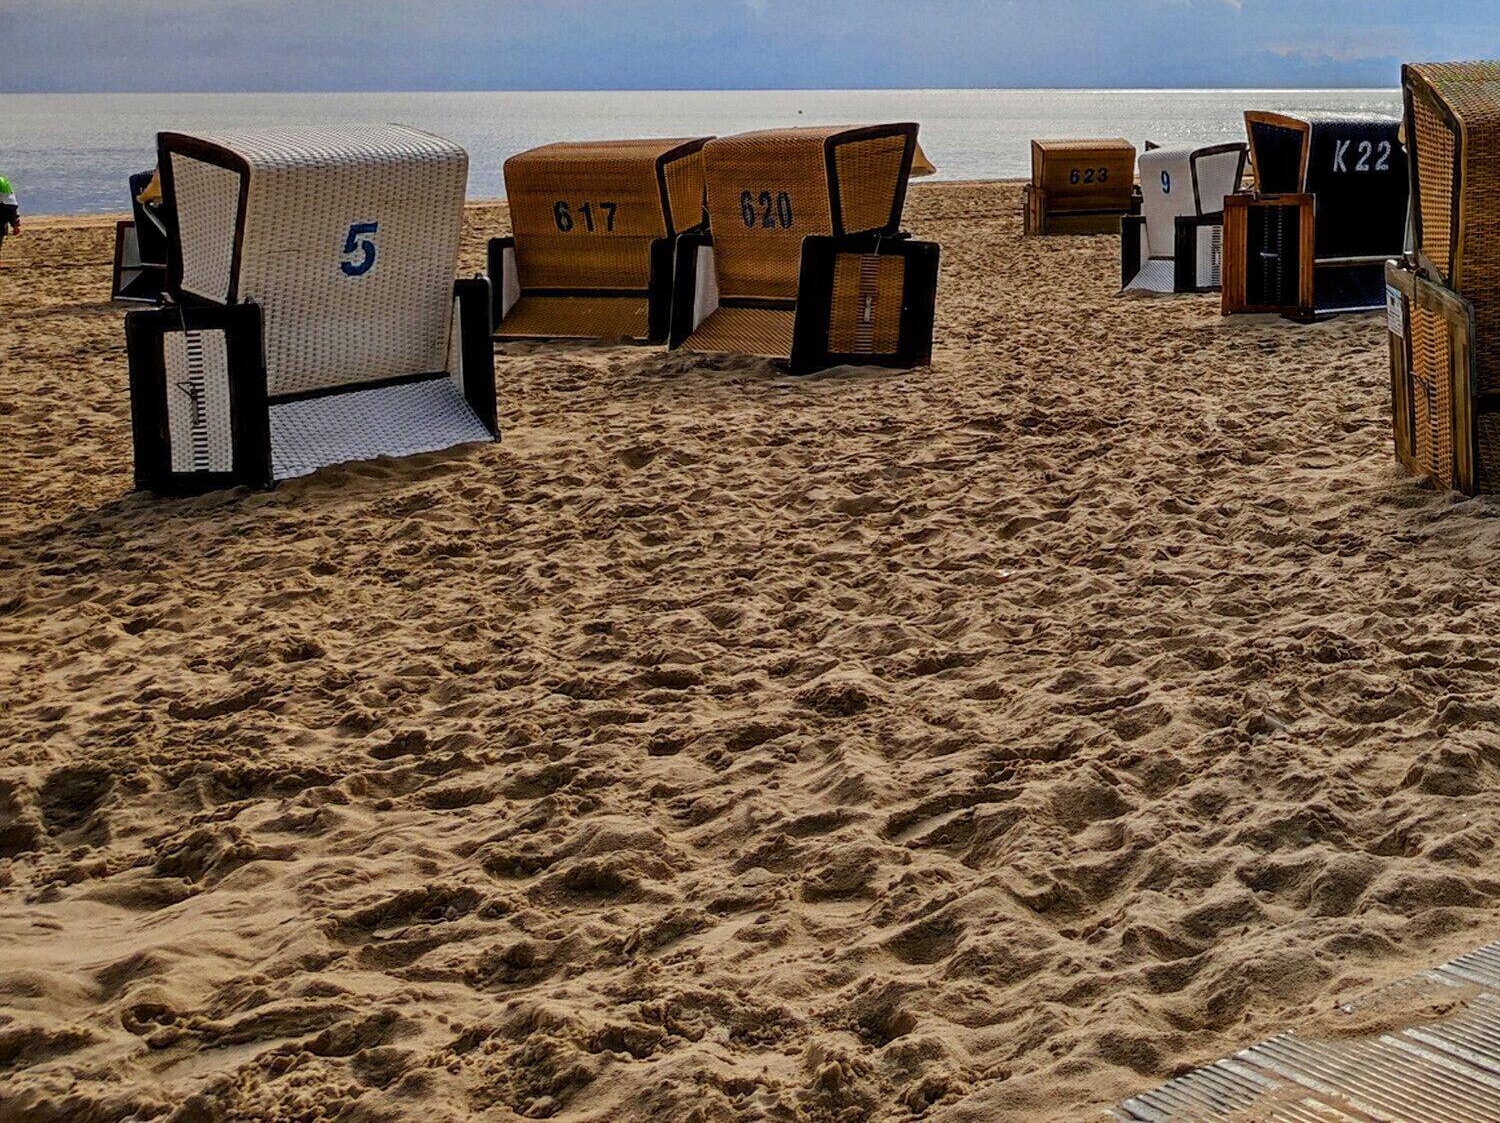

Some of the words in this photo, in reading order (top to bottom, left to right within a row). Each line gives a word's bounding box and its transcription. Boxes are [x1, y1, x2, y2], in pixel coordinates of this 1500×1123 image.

[1069, 167, 1108, 185] 623
[1161, 170, 1170, 194] 9
[553, 200, 618, 233] 617
[740, 190, 793, 229] 620
[340, 221, 378, 276] 5
